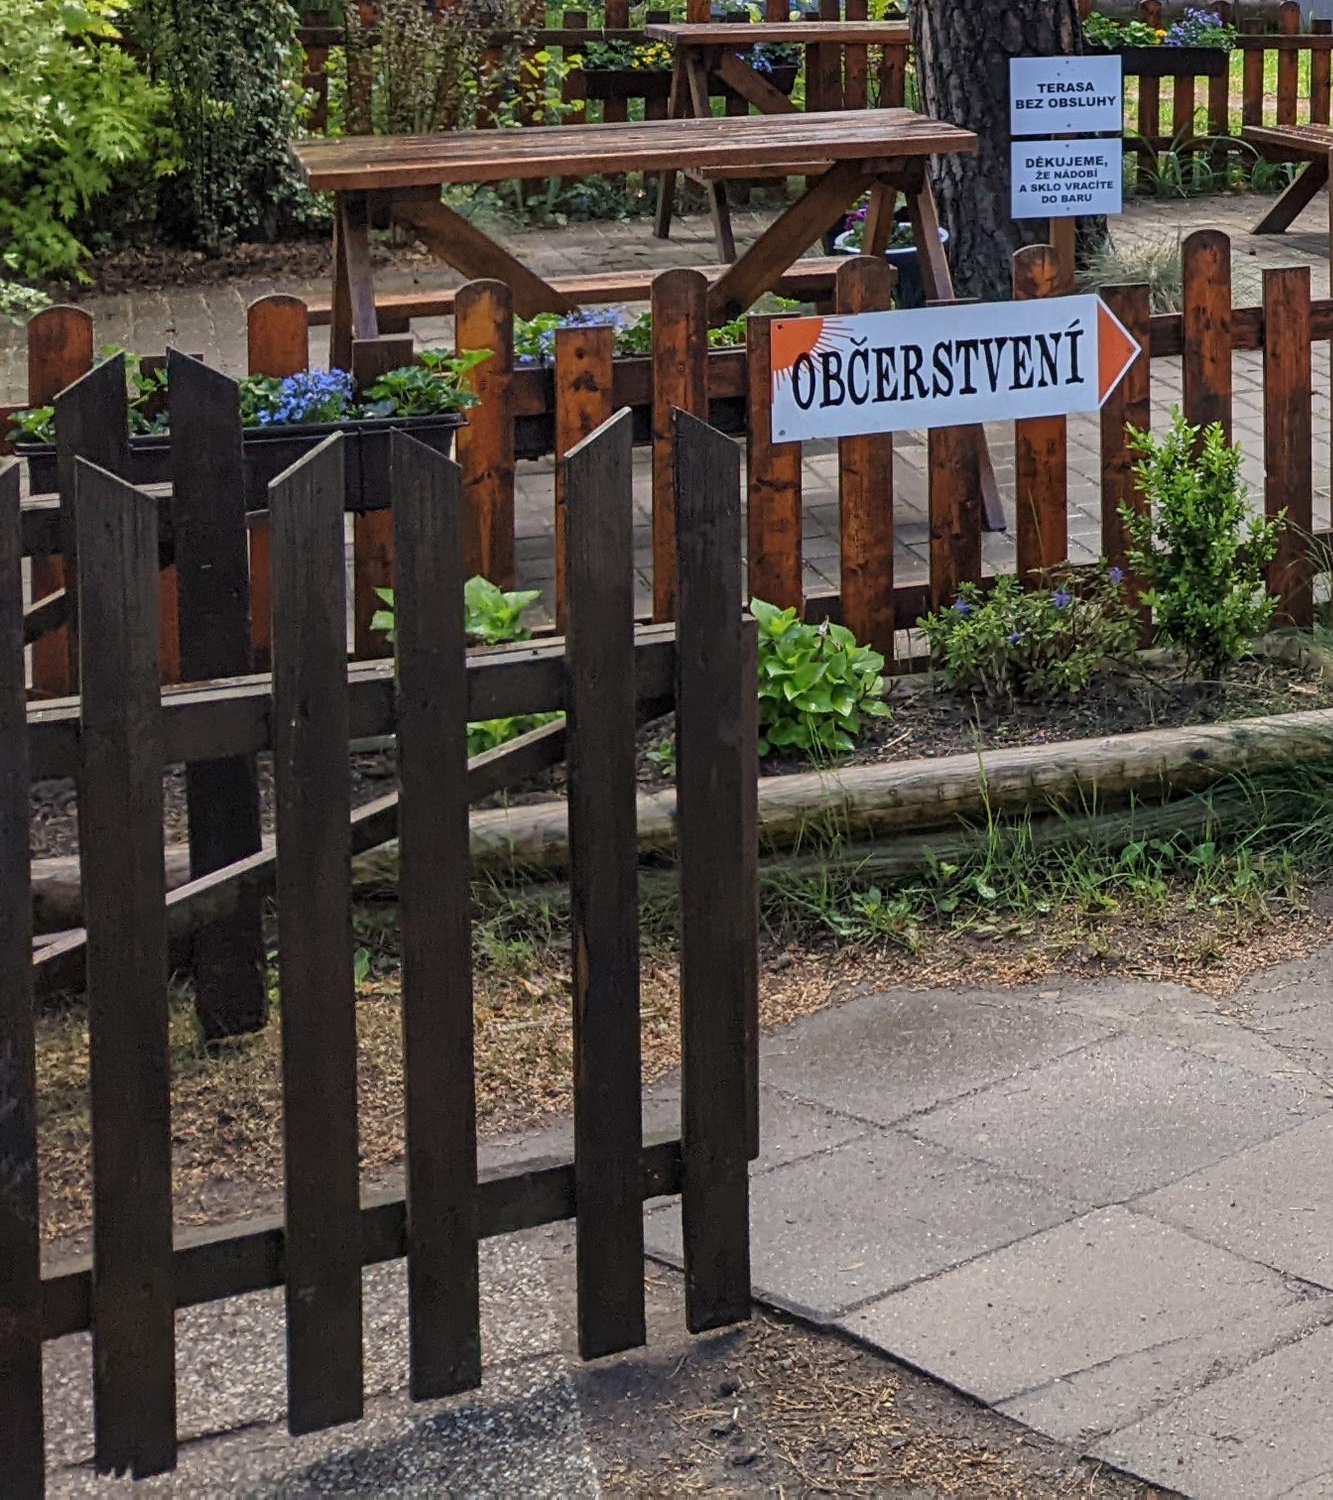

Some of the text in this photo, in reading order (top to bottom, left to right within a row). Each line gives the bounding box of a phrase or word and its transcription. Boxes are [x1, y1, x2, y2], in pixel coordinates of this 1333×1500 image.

[1037, 82, 1095, 94] TERASA
[1015, 96, 1117, 109] BEZ OBSLUHY
[1025, 155, 1108, 168] DĚKUJEME,
[1035, 168, 1098, 180] ŽE NÁDOBÍ
[1019, 179, 1114, 193] A SKLO VRACÍTE
[1041, 193, 1092, 204] DO BARU
[791, 317, 1085, 411] OBČERSTVENÍ
